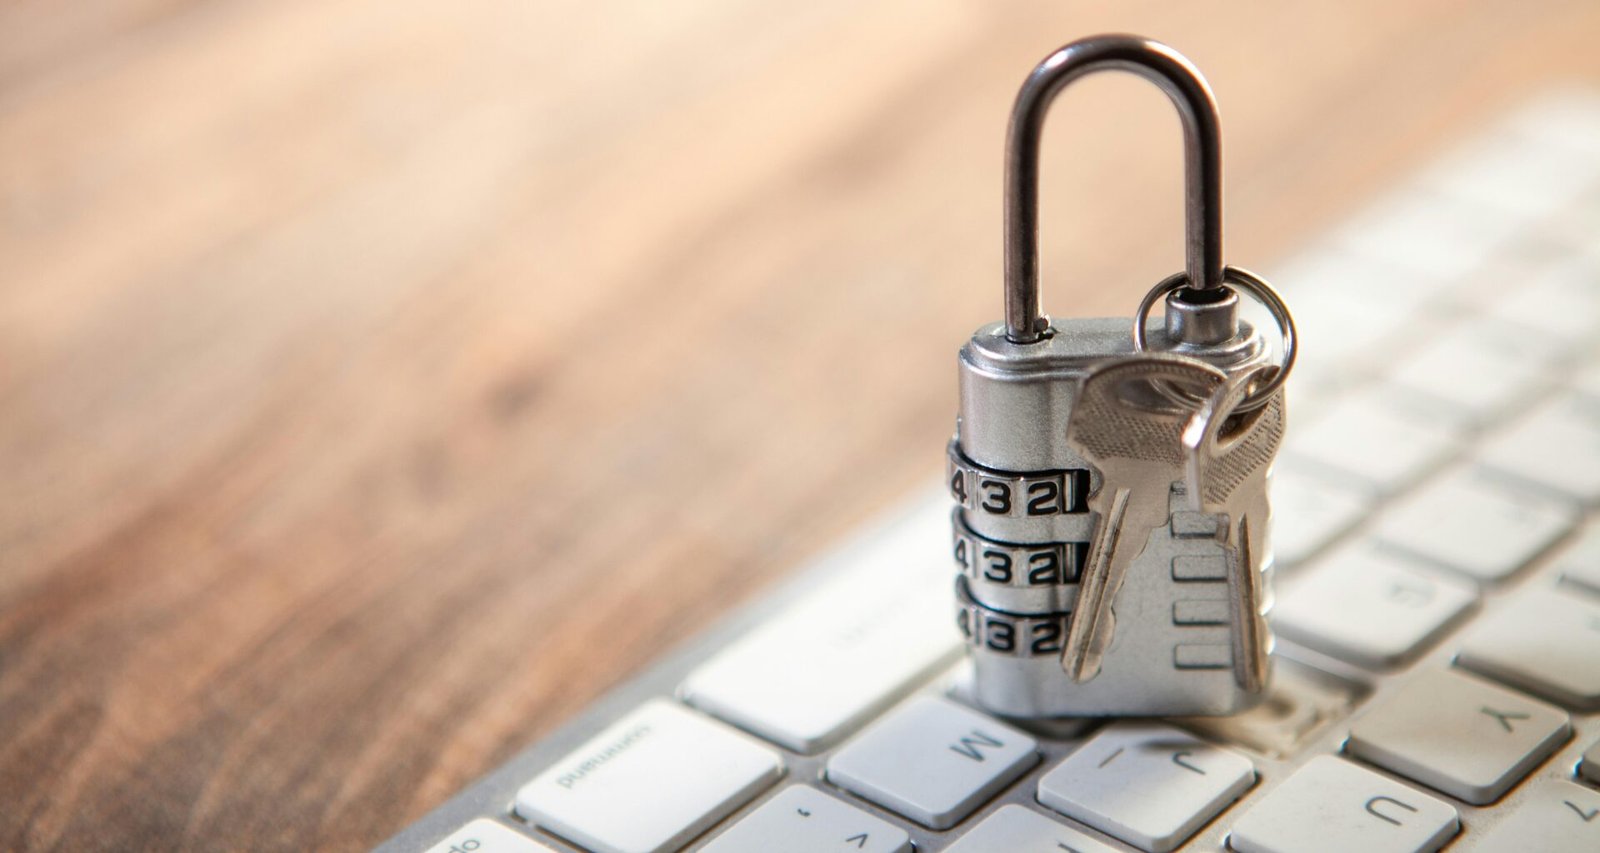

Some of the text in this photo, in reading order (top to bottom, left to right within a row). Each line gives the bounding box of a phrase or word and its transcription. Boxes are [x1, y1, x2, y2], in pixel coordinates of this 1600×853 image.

[1480, 706, 1531, 733] Y
[949, 729, 1004, 762] M
[1365, 796, 1418, 826] U
